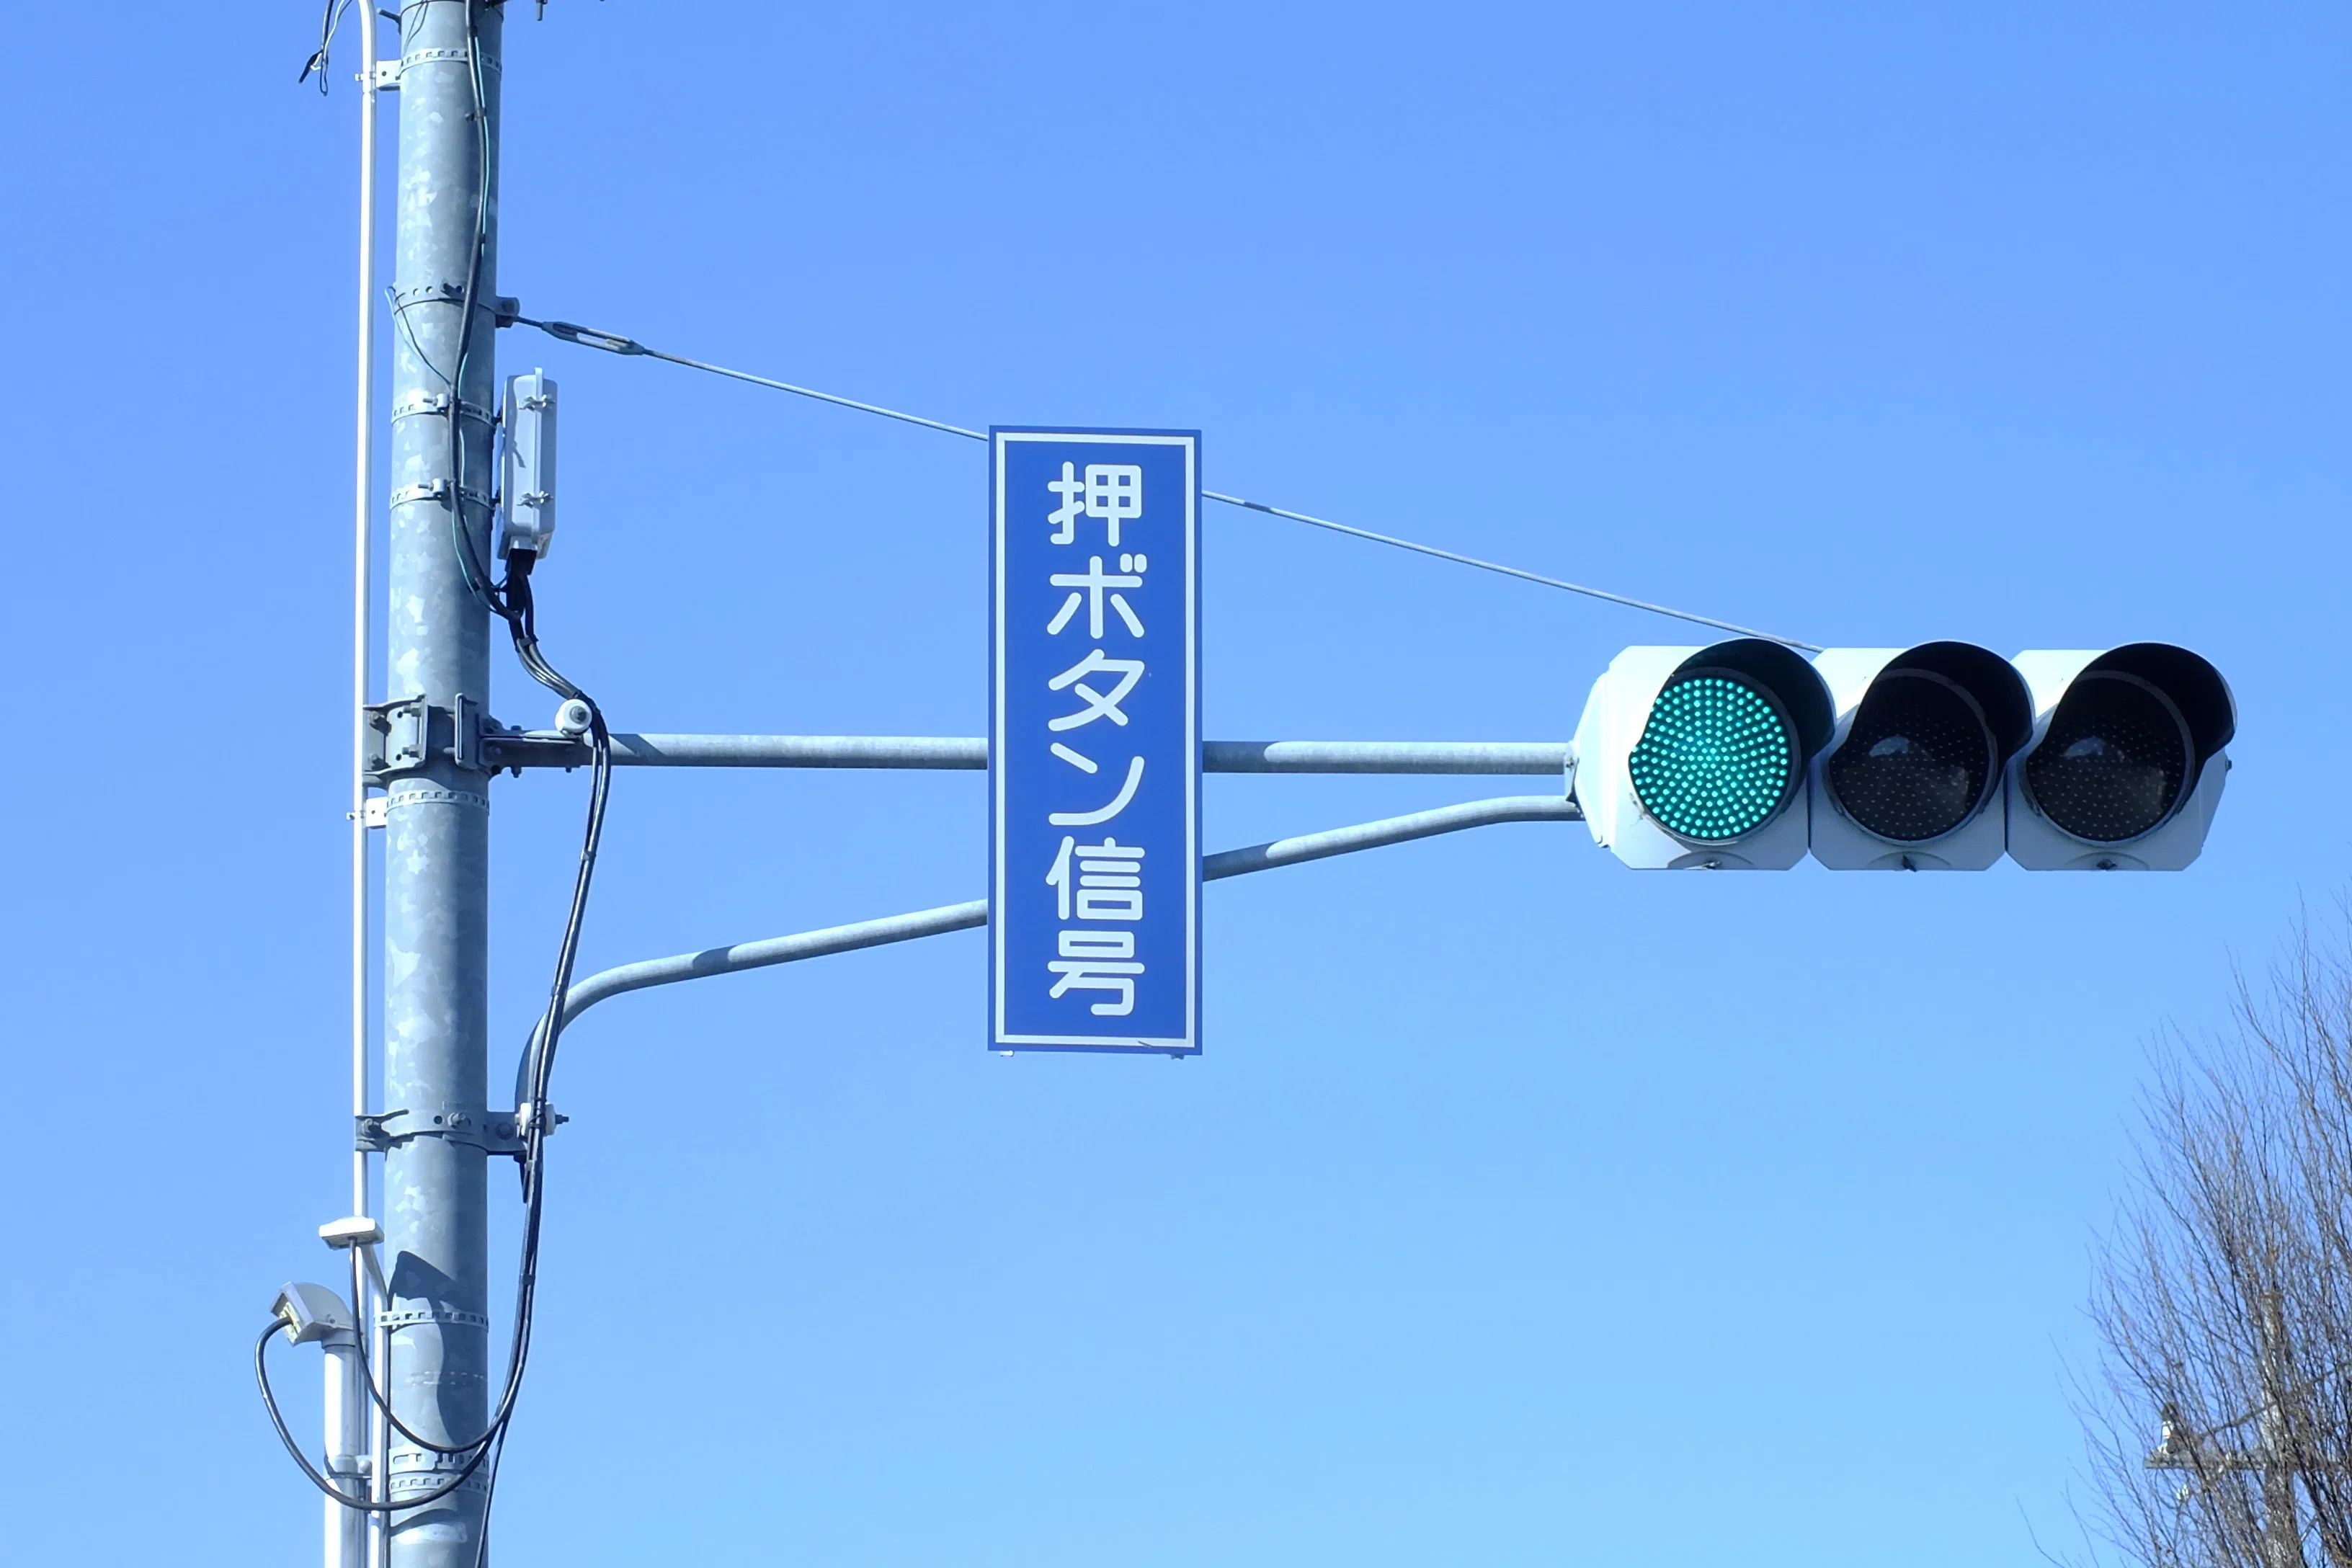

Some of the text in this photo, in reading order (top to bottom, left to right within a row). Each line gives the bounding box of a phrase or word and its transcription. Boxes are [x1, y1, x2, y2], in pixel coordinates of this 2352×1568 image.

[1046, 461, 1147, 1016] 押ボタン信号
